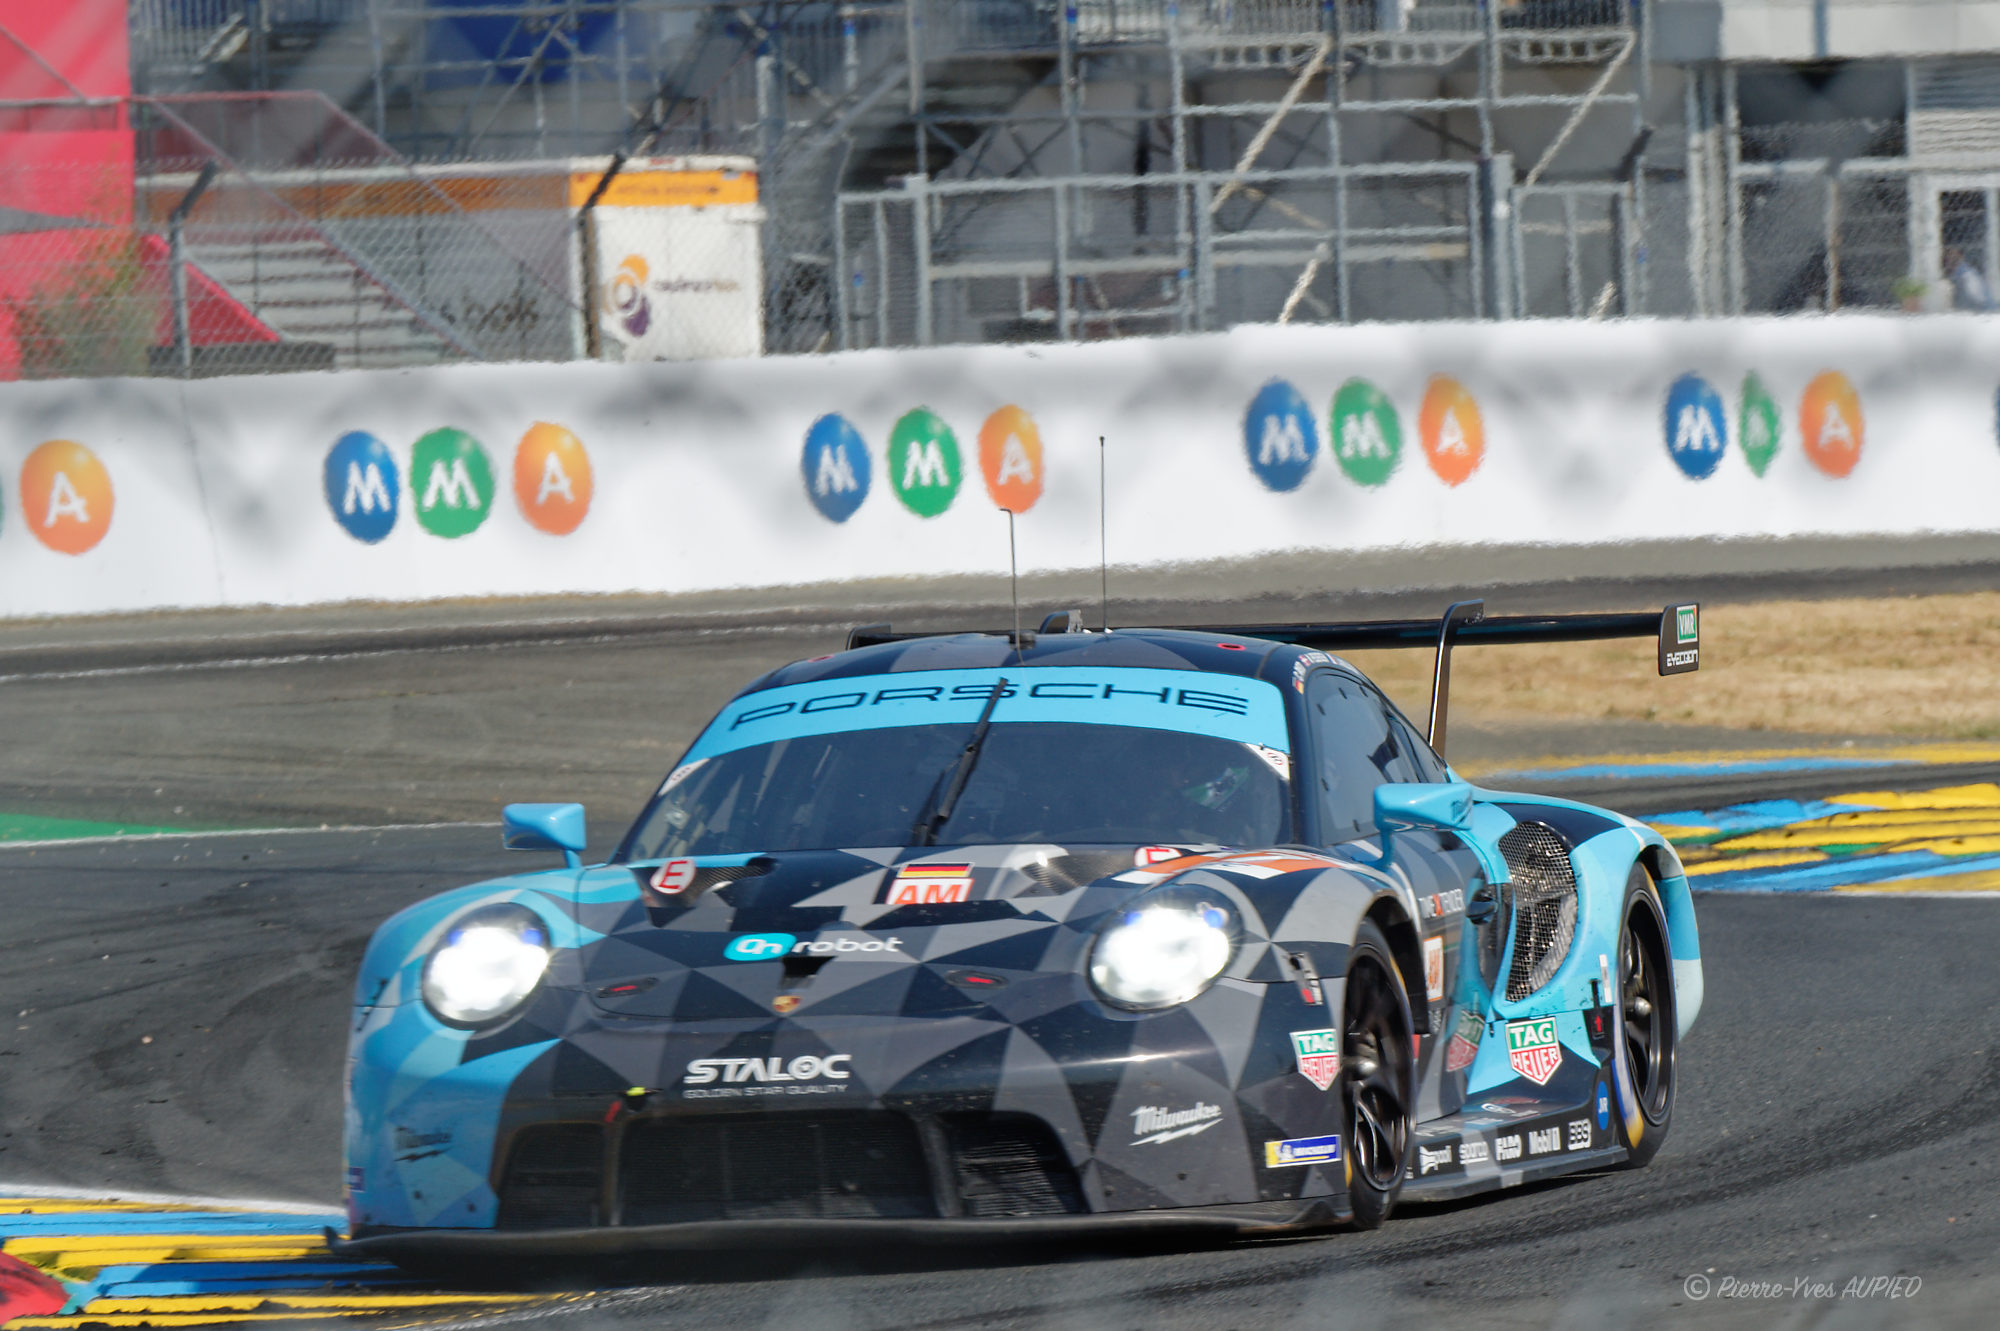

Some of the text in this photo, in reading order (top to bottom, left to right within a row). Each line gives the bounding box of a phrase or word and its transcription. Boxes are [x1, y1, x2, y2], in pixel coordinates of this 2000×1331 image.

[730, 682, 1249, 731] PORSCHE
[659, 860, 689, 890] E
[893, 884, 957, 905] AM
[1297, 1033, 1336, 1053] TAG
[1509, 1022, 1554, 1048] TAG
[682, 1054, 852, 1084] STALOC
[1511, 1047, 1558, 1079] HEUER
[682, 1084, 848, 1099] GOLDEN STAR QUALITY
